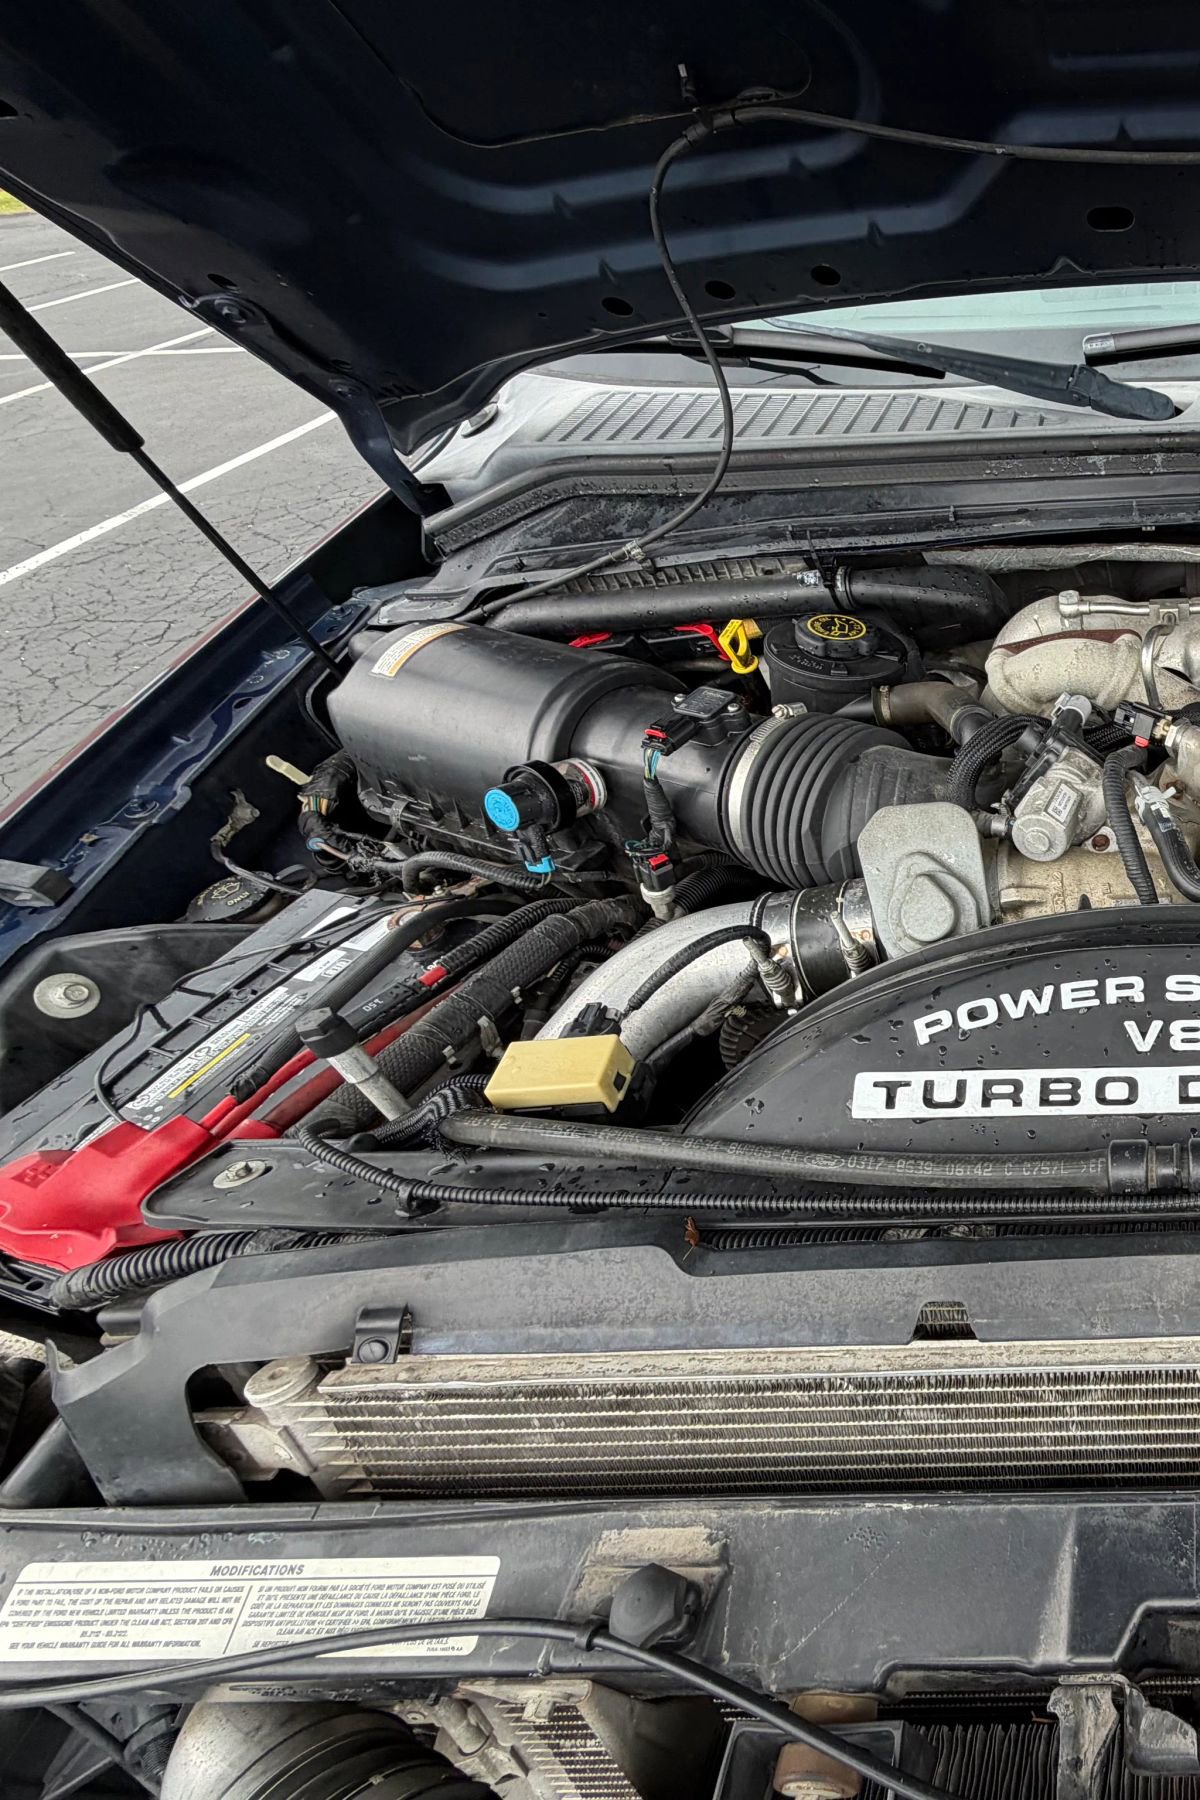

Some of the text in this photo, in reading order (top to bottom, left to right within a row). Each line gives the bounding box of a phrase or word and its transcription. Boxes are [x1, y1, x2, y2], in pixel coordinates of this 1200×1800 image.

[913, 975, 1145, 1046] POWER
[872, 1076, 1139, 1111] TURBO
[210, 1564, 305, 1578] MODIFICATIONS
